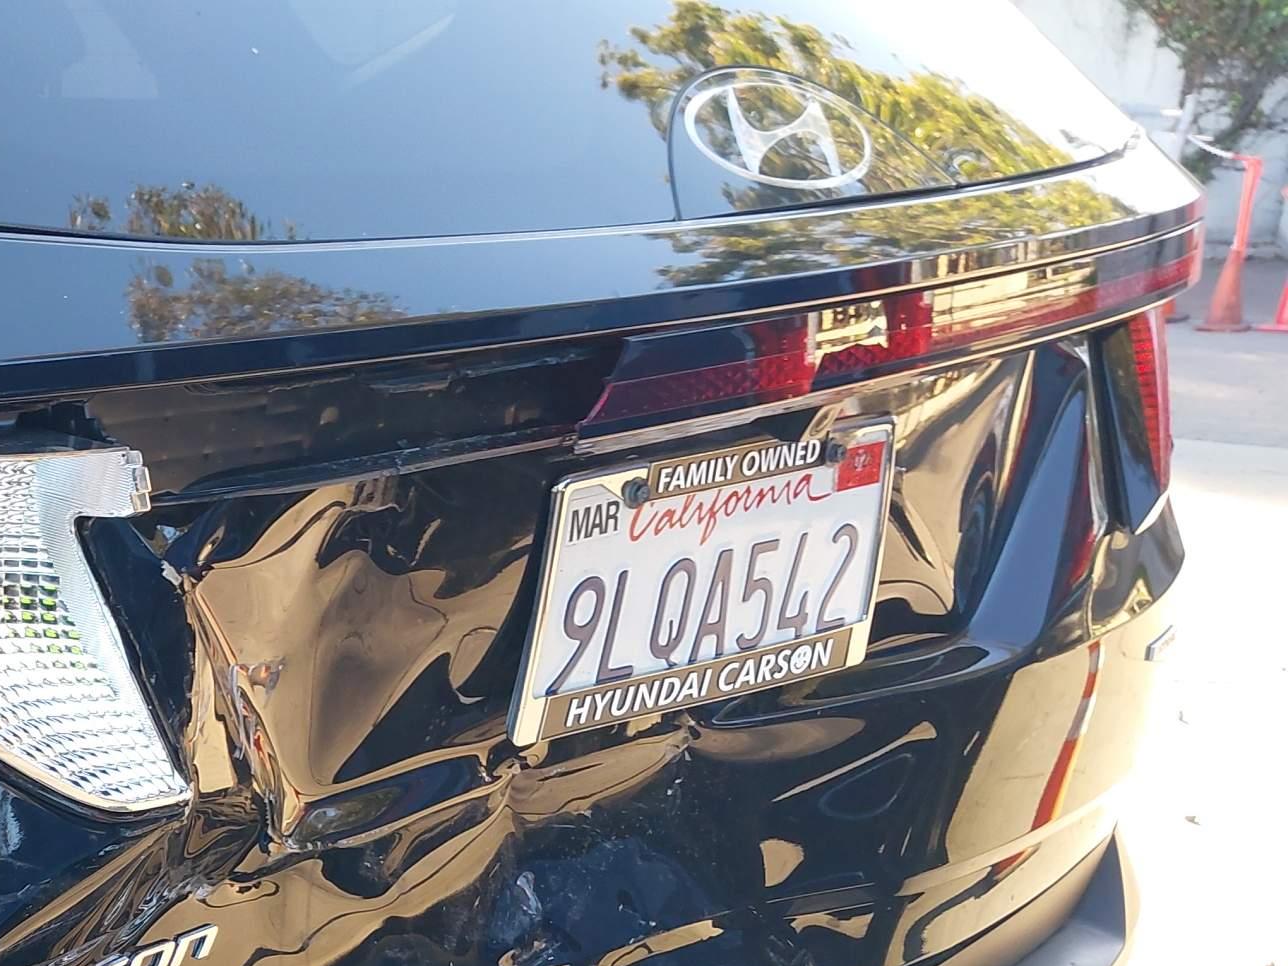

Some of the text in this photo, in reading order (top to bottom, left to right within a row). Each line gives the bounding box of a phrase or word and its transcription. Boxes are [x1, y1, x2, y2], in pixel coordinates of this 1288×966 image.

[658, 455, 739, 493] FAMILY
[742, 439, 820, 474] OWNED
[569, 500, 620, 542] MAR
[629, 472, 831, 545] California
[545, 523, 858, 695] 9LQA542
[566, 639, 833, 727] HYUNDAI CARSON
